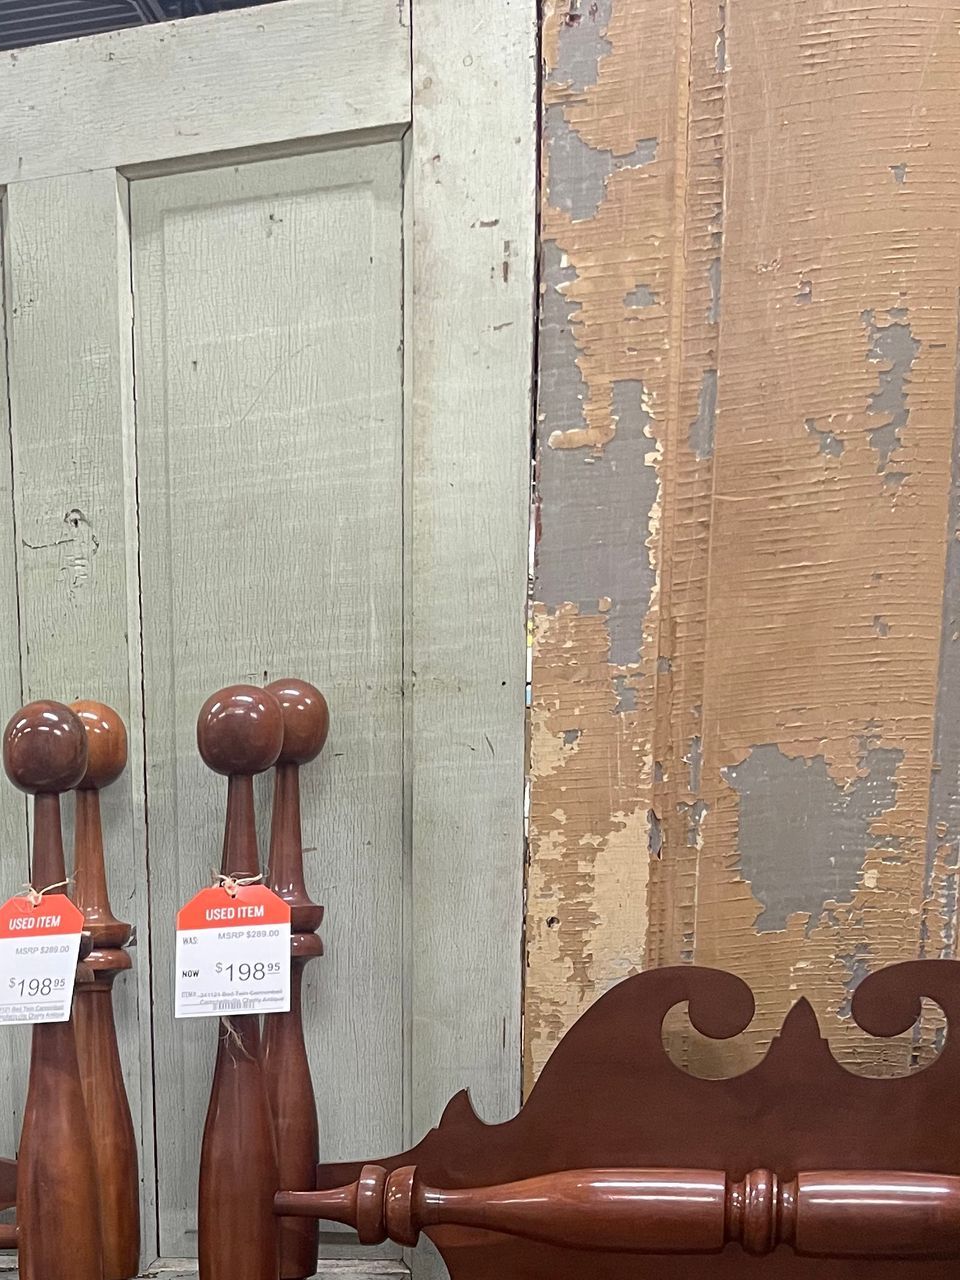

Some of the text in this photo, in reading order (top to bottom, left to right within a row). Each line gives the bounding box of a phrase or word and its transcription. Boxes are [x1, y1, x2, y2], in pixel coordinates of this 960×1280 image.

[206, 905, 265, 921] USED ITEM
[9, 916, 61, 931] USED ITEM
[218, 932, 244, 940] MSRP
[15, 947, 39, 955] MSRP
[182, 970, 200, 978] NOW
